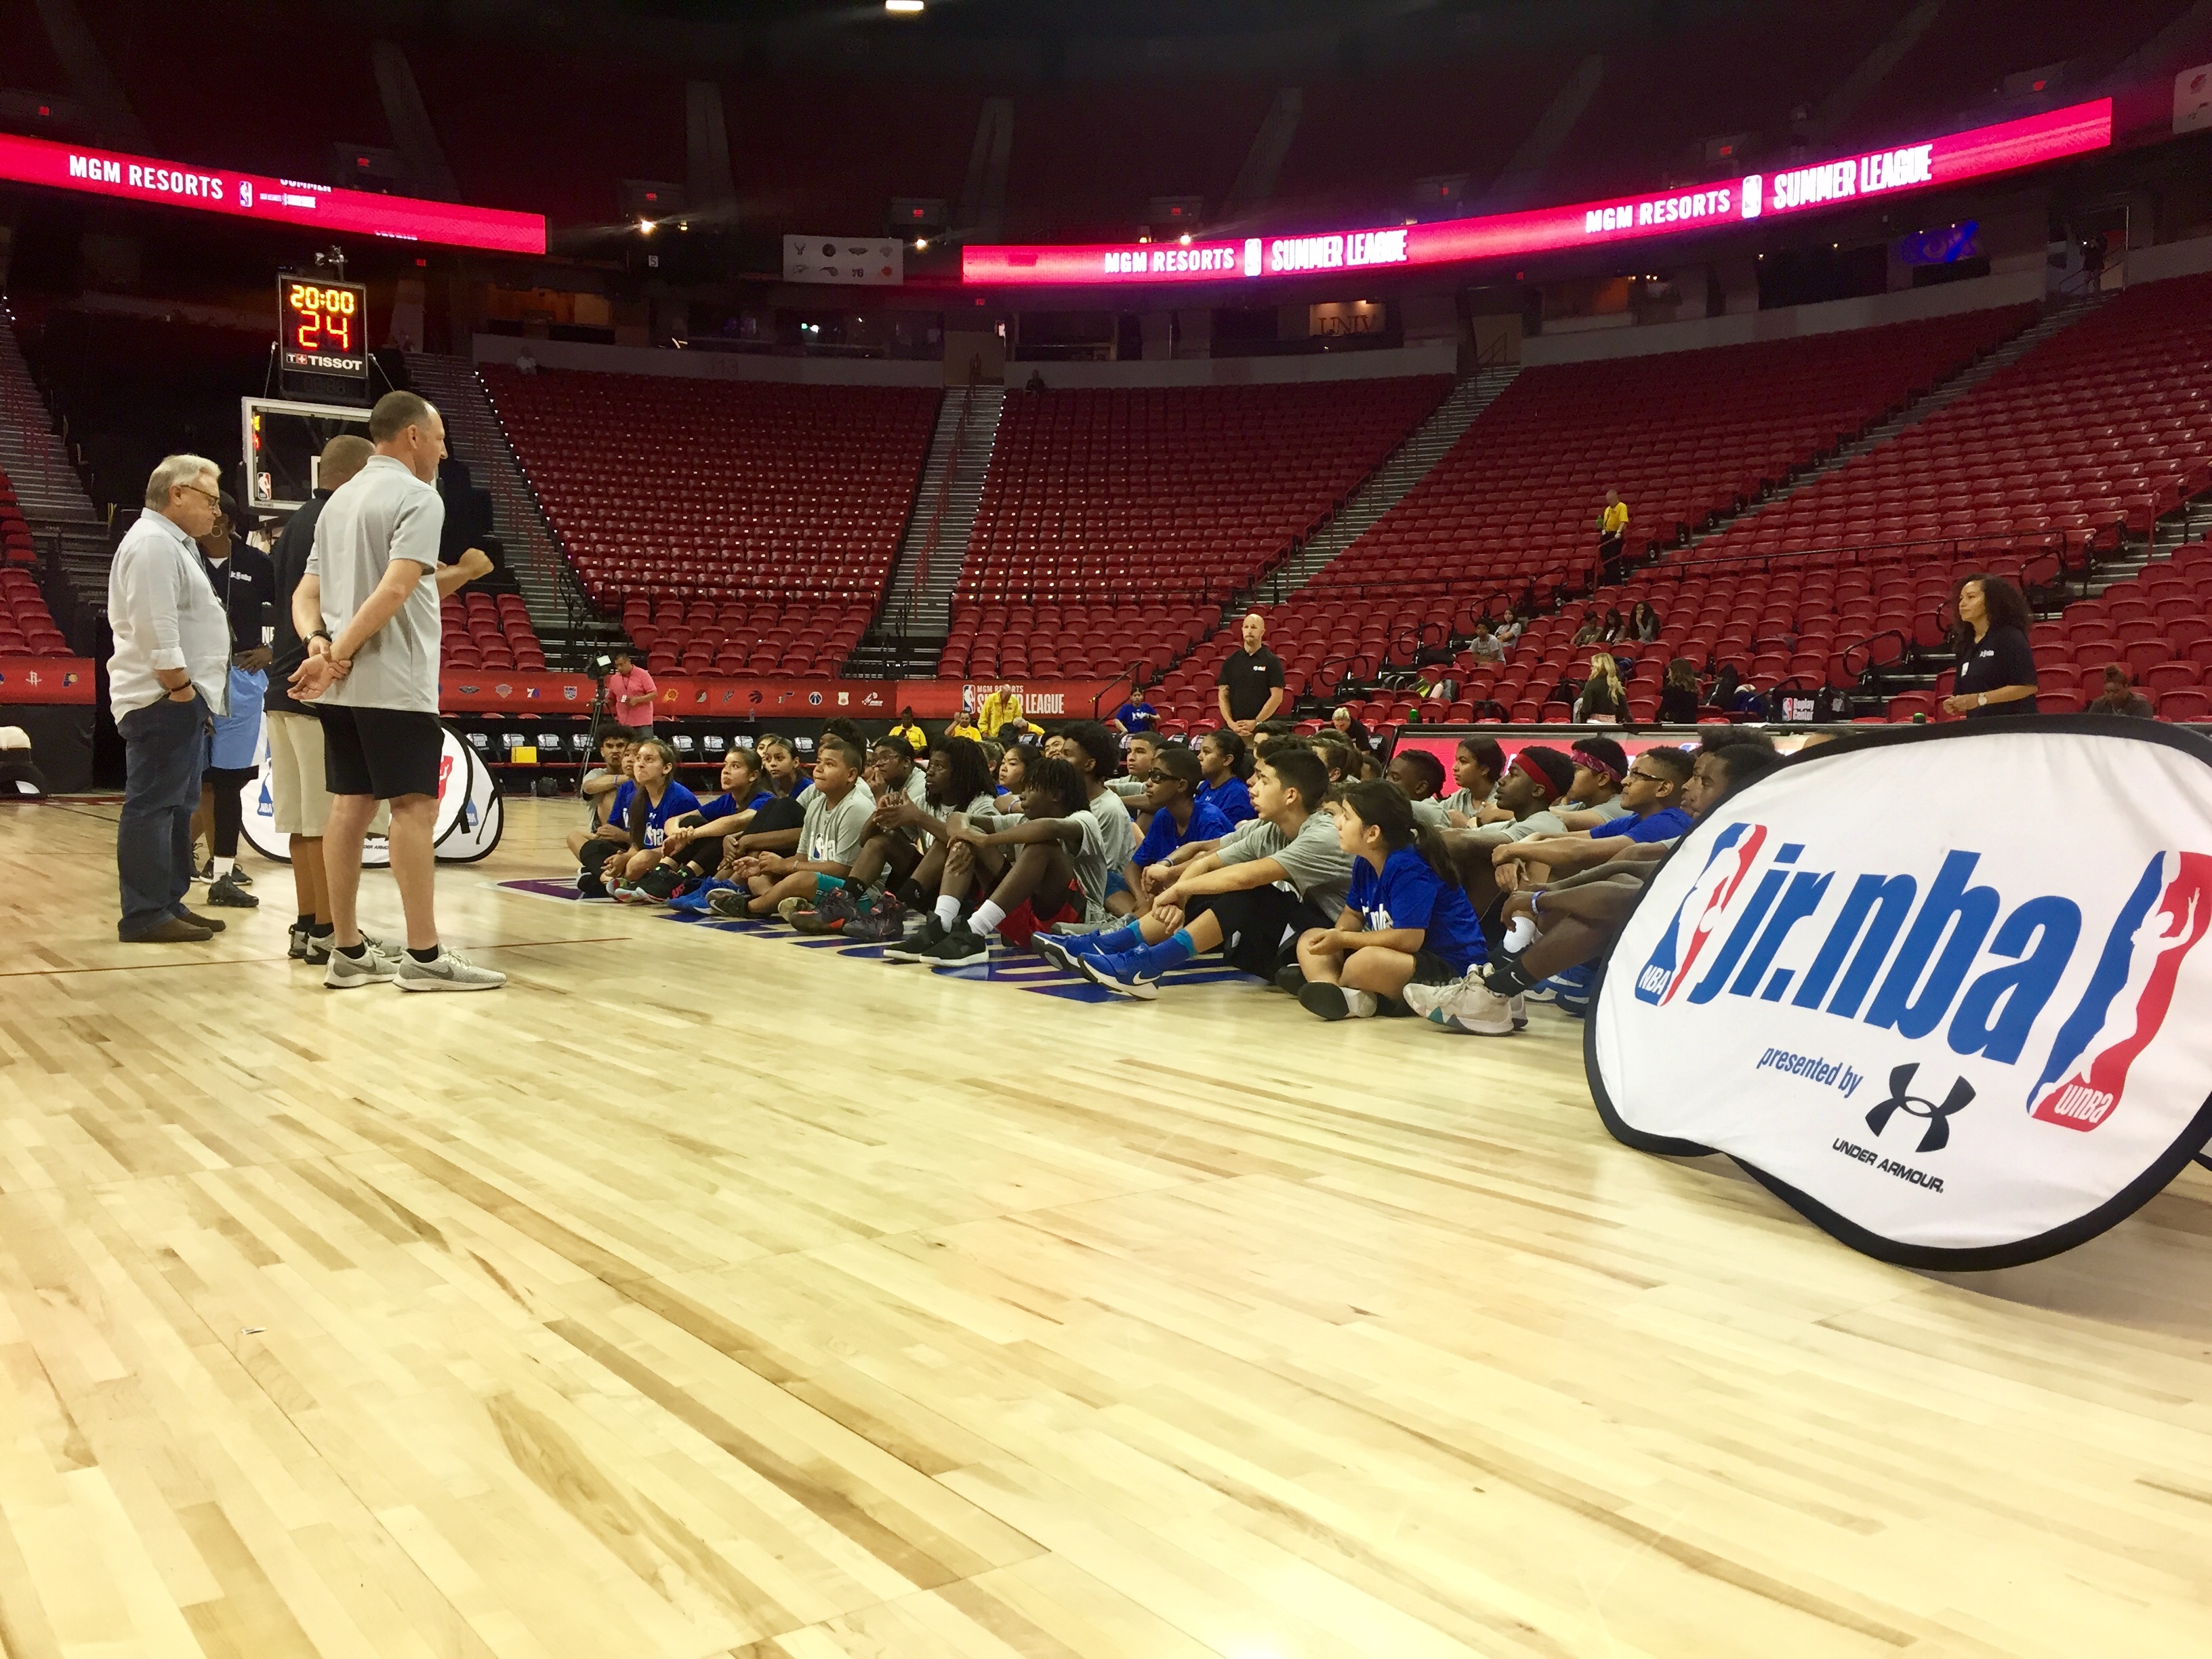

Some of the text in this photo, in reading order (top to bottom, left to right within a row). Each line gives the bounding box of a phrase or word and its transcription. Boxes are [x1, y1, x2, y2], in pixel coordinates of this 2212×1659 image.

[69, 155, 223, 199] MGM RESORTS
[1585, 144, 1933, 234] MGM RESORTS SUMMER LEAGUE
[1105, 229, 1408, 273] MGM RESORTS SUMMER LEAGUE
[291, 285, 354, 314] 20:00
[298, 310, 348, 349] 24
[308, 355, 363, 371] TISSOT
[1025, 693, 1065, 714] LEAGUE
[1793, 709, 1814, 721] Center
[1686, 842, 2083, 1066] jr.nba
[1638, 964, 1672, 996] NBA
[1756, 1047, 1864, 1099] presented by
[1832, 1137, 1879, 1166] UNDER
